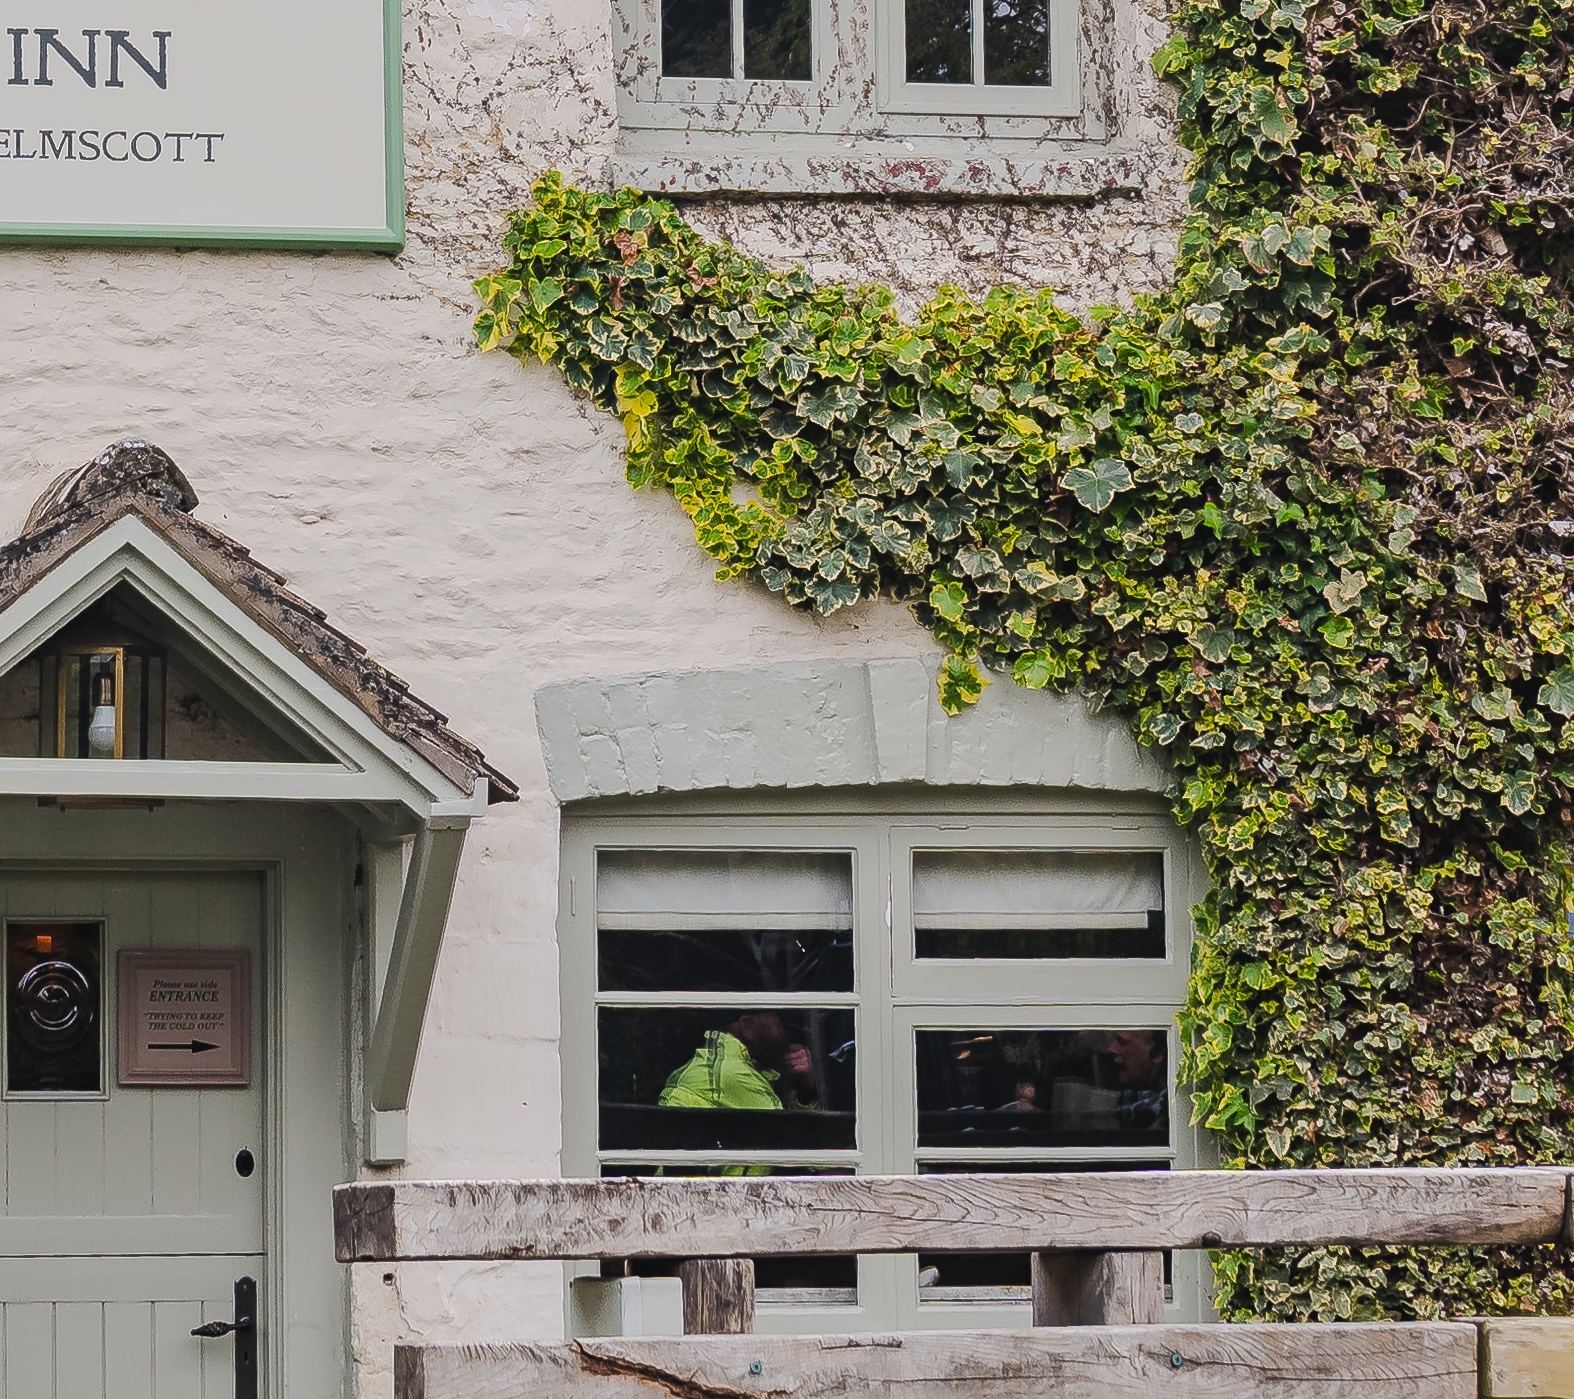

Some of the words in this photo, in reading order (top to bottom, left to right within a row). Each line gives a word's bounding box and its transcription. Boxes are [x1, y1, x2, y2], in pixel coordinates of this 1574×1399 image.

[5, 26, 172, 90] INN
[153, 979, 182, 989] Please
[149, 990, 220, 1002] ENTRANCE
[184, 1011, 198, 1021] TO
[199, 1012, 225, 1021] KEEP
[148, 1022, 168, 1031] THE
[169, 1022, 195, 1031] COLD
